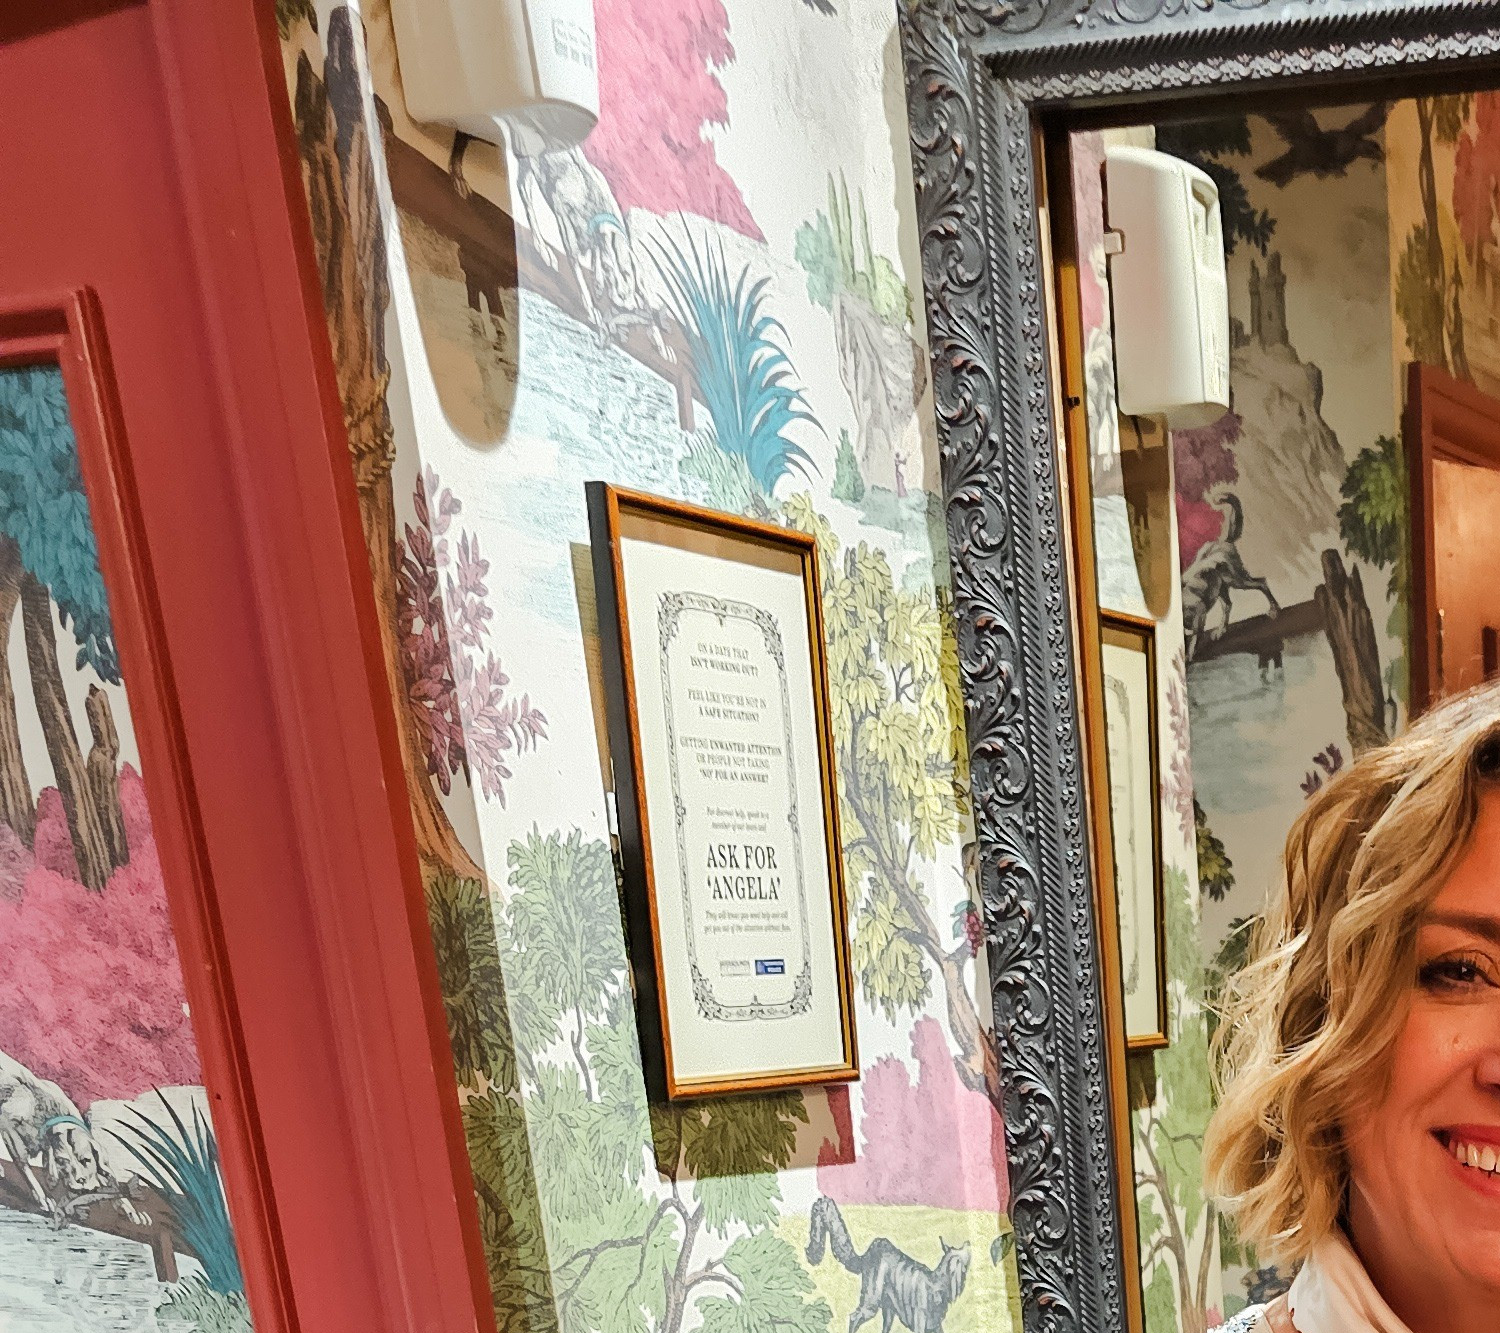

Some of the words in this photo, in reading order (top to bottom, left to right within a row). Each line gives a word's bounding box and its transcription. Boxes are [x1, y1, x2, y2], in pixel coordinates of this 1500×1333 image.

[698, 643, 707, 653] ON
[715, 645, 731, 657] DATE
[733, 648, 749, 660] THAT
[710, 659, 740, 673] WORKING
[688, 689, 705, 701] FEEL
[705, 690, 721, 703] LIKE
[745, 697, 758, 708] NOT
[705, 707, 721, 719] SAFE
[709, 739, 746, 753] UNWANTED
[747, 744, 782, 756] ATTENTION
[707, 754, 731, 767] PEOPLE
[732, 757, 745, 767] NOT
[747, 758, 770, 769] TAKING
[707, 844, 740, 869] ASK
[744, 845, 778, 869] FOR
